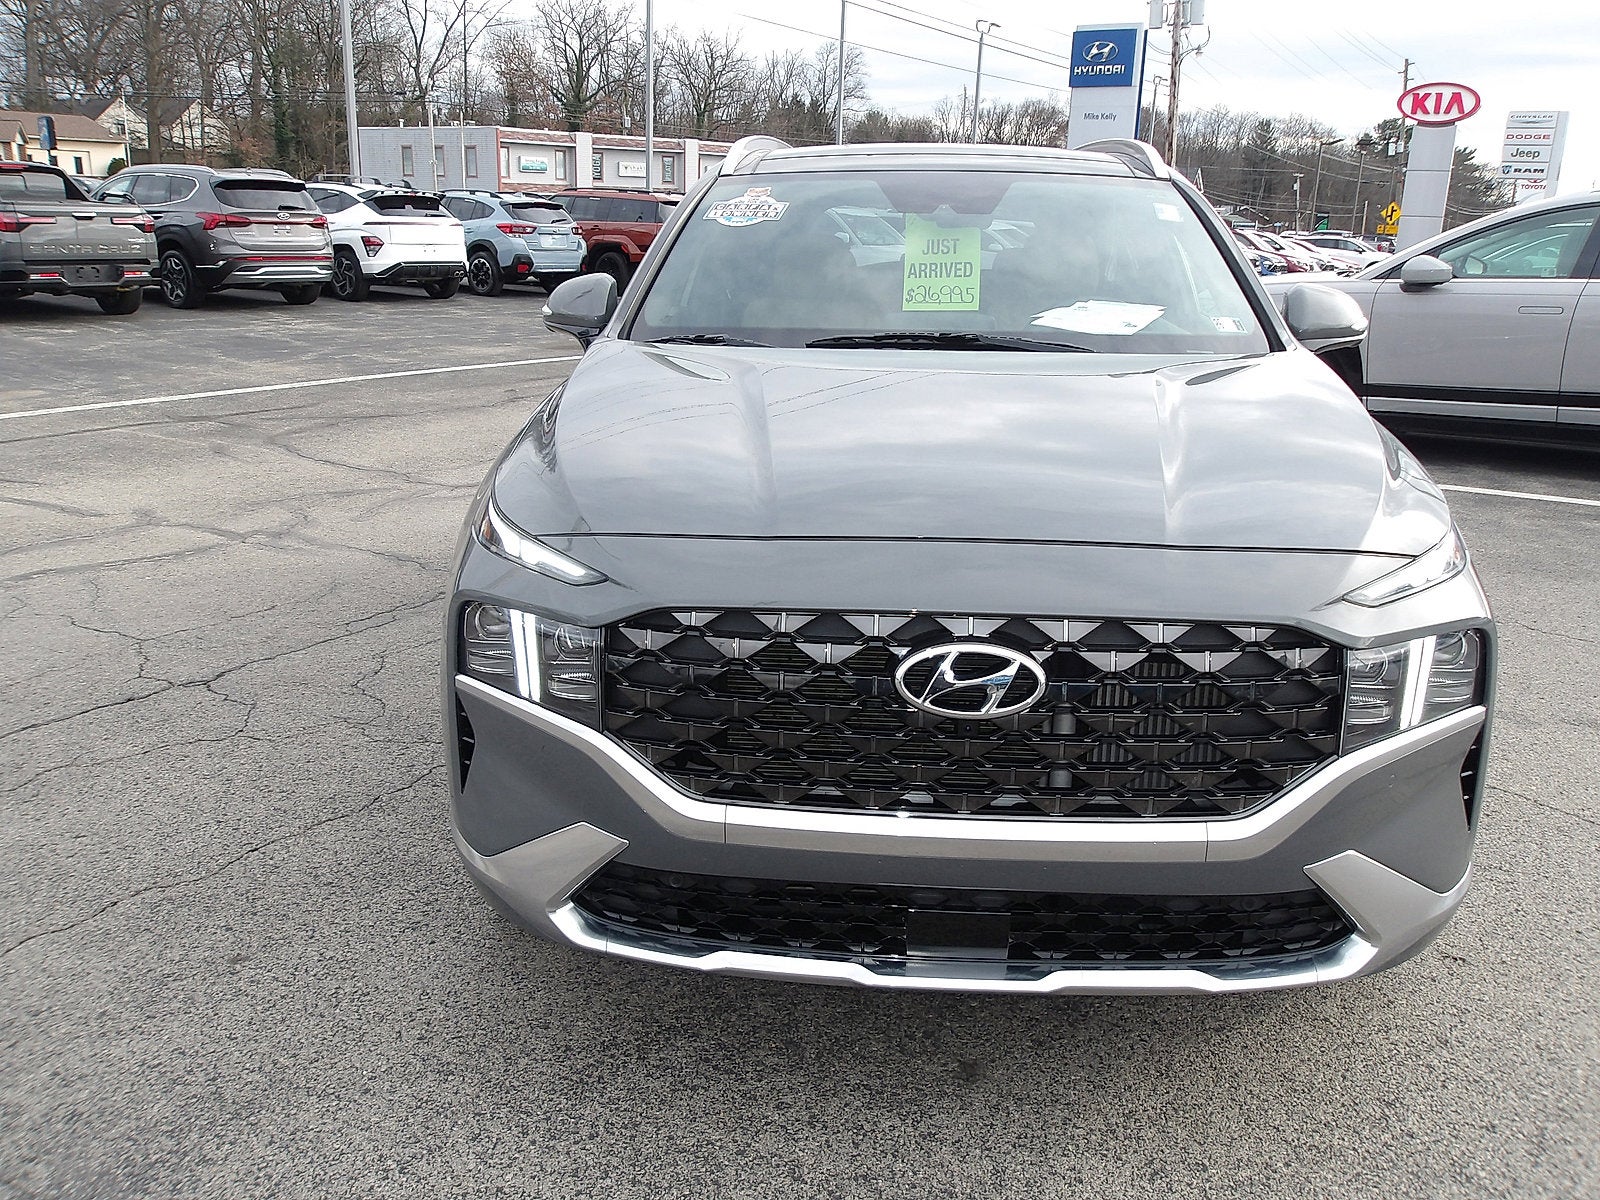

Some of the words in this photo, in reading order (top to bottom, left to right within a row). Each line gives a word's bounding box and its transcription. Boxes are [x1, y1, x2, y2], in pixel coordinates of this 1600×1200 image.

[1073, 64, 1126, 76] HYUNDAI
[1410, 92, 1465, 115] KIA
[1083, 112, 1099, 120] Mike
[1100, 112, 1117, 122] Kelly
[1510, 147, 1540, 160] Jeep
[592, 155, 601, 179] YOGA
[97, 244, 142, 255] CRUZ
[922, 239, 961, 256] JUST
[907, 262, 974, 278] ARRIVED
